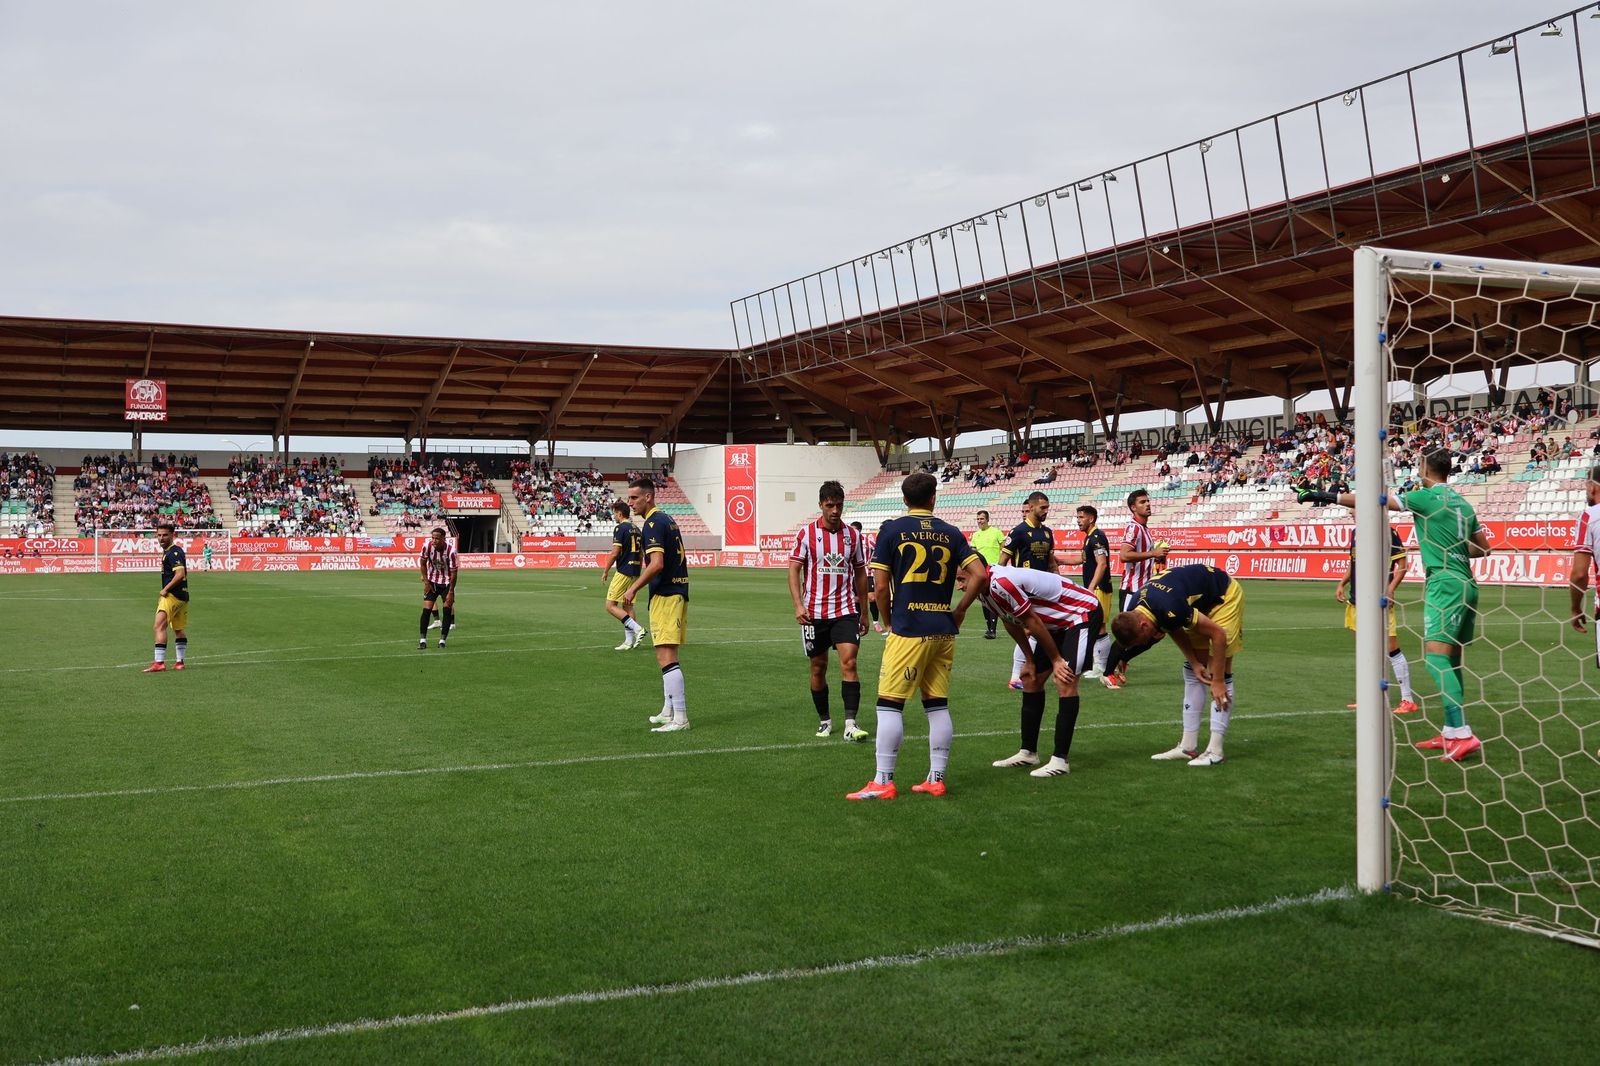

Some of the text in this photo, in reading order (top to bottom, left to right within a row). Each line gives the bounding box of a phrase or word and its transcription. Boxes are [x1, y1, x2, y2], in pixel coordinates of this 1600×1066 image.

[1093, 426, 1181, 452] ETADIO
[735, 500, 746, 517] 8
[1506, 522, 1567, 537] recoletas
[912, 531, 950, 544] VERGÉS
[111, 538, 161, 554] ZAMOR
[184, 558, 225, 570] AMORA
[264, 563, 300, 571] ZAMORA
[311, 563, 360, 571] ZAMORANAS
[897, 541, 951, 585] 23
[1259, 555, 1307, 573] FEDERACIÓN
[1330, 559, 1351, 569] VERS
[804, 625, 815, 640] 20
